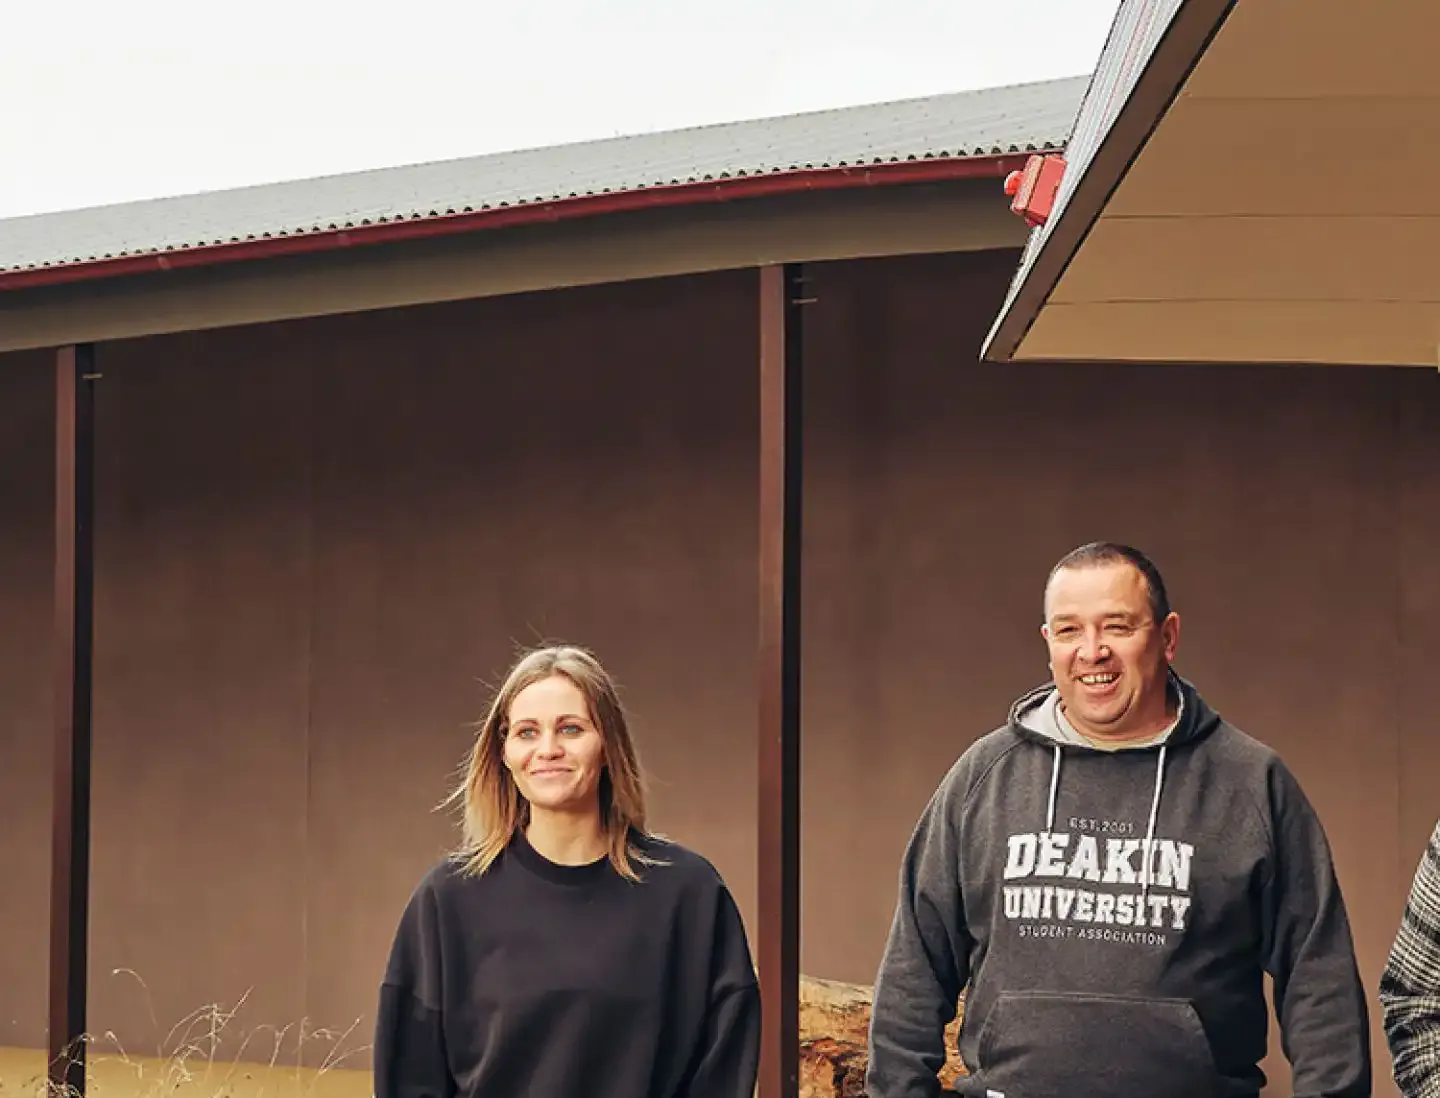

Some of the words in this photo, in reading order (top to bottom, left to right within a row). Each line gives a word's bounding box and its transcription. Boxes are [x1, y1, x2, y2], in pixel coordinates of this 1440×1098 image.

[1003, 832, 1194, 891] DEAKIN
[1003, 886, 1191, 930] UNIVERSITY
[1019, 924, 1074, 938] STUDENT
[1078, 927, 1167, 946] ASSOCIATION
